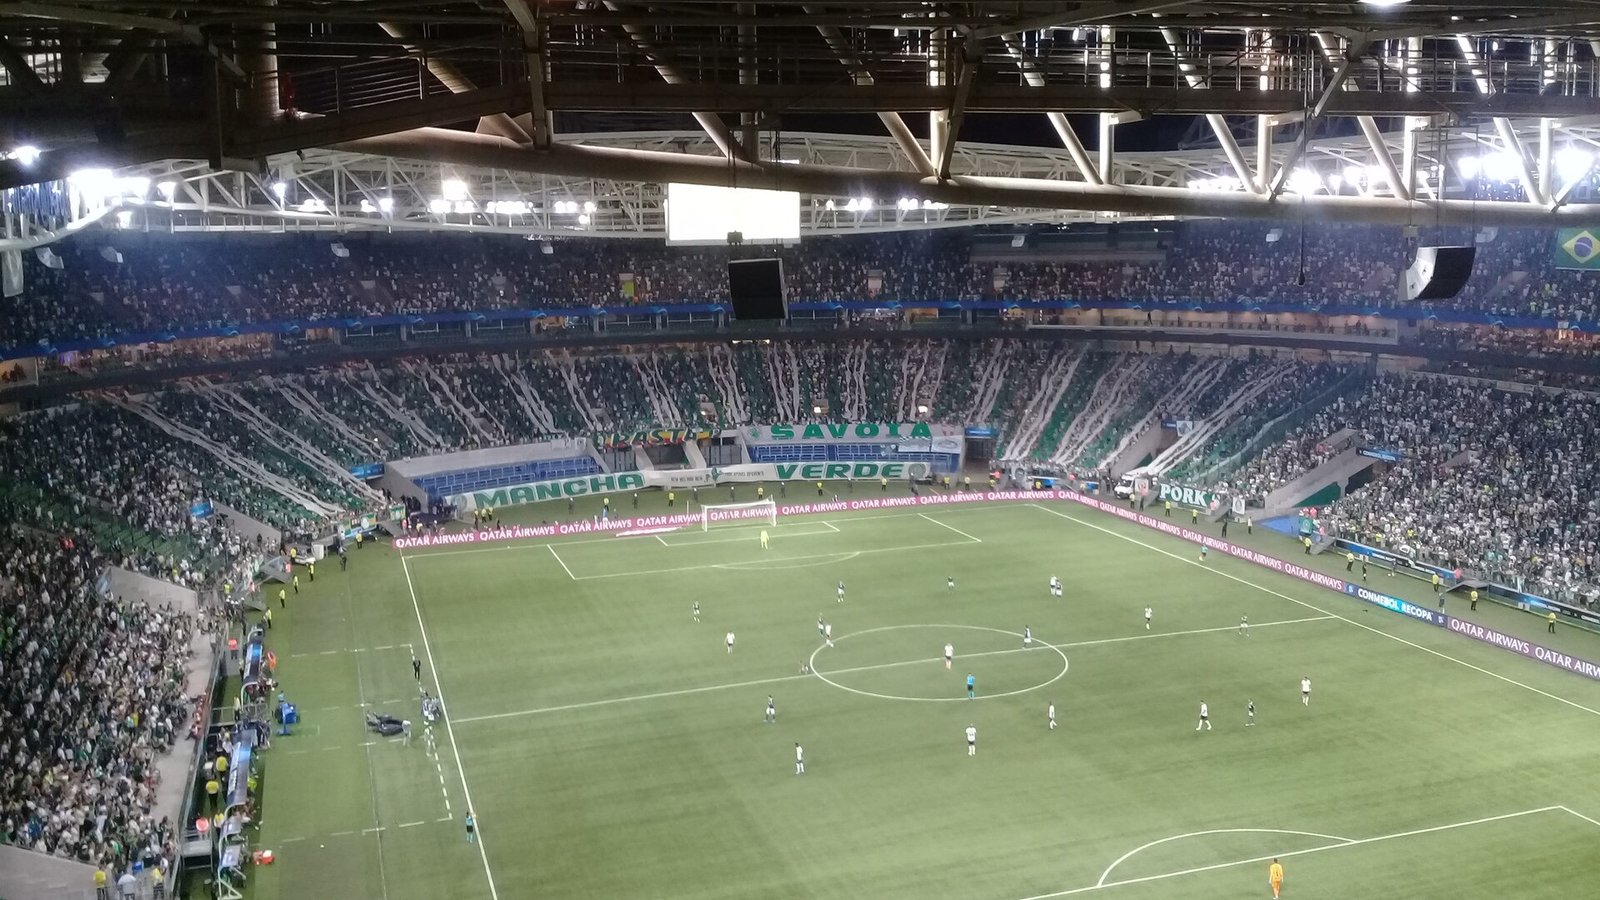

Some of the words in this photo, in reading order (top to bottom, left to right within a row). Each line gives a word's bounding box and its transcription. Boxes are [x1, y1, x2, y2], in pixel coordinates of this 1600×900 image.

[770, 423, 932, 439] SAVOIA
[776, 463, 905, 479] VERDE
[473, 474, 645, 508] MANCHA
[920, 495, 948, 504] QATAR
[950, 492, 984, 502] AIRWAYS
[988, 491, 1016, 500] QATAR
[1018, 490, 1054, 499] AIRWAYS
[1160, 483, 1208, 507] PORK
[782, 505, 811, 515] QATAR
[812, 502, 848, 512] AIRWAYS
[851, 500, 880, 509] QATAR
[881, 497, 917, 507] AIRWAYS
[637, 517, 667, 527] QATAR
[668, 514, 706, 525] AIRWAYS
[711, 510, 739, 521] QATAR
[479, 530, 513, 541] QATAR
[514, 527, 555, 538] AIRWAYS
[560, 523, 591, 534] QATAR
[593, 519, 632, 531] AIRWAYS
[396, 536, 430, 548] QATAR
[433, 533, 475, 545] AIRWAYS
[1183, 529, 1202, 544] QATAR
[1202, 537, 1228, 552] AIRWAYS
[1230, 545, 1253, 561] QATAR
[1254, 553, 1282, 570] AIRWAYS
[1285, 563, 1309, 580] QATAR
[1310, 572, 1342, 590] AIRWAYS
[1358, 588, 1400, 611] CONMEBOL
[1401, 604, 1432, 621] RECOPA
[1451, 618, 1484, 639] QATAR
[1486, 631, 1530, 654] AIRWAYS
[1535, 646, 1572, 669] QATAR
